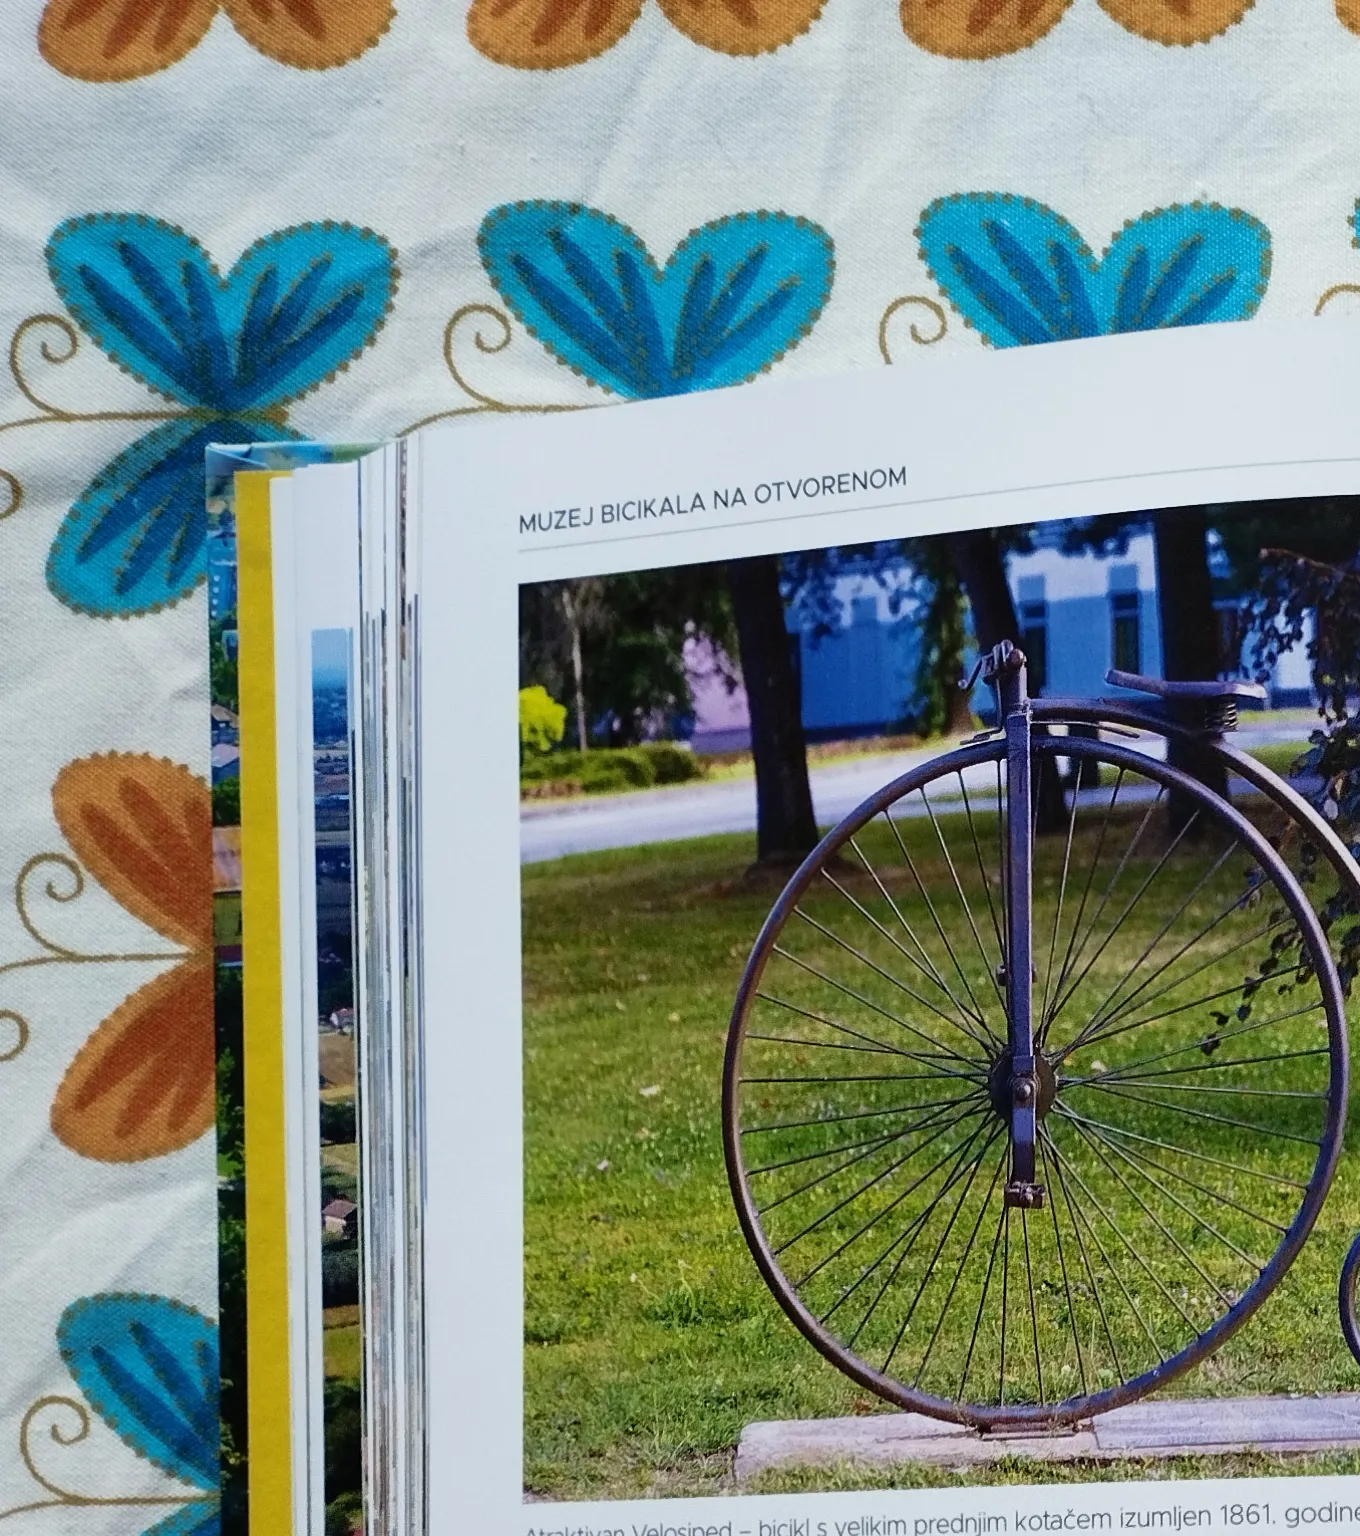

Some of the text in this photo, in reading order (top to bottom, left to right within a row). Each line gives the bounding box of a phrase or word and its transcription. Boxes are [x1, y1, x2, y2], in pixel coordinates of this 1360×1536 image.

[518, 466, 909, 534] MUZEJ BICIKALA NA OTVORENOM
